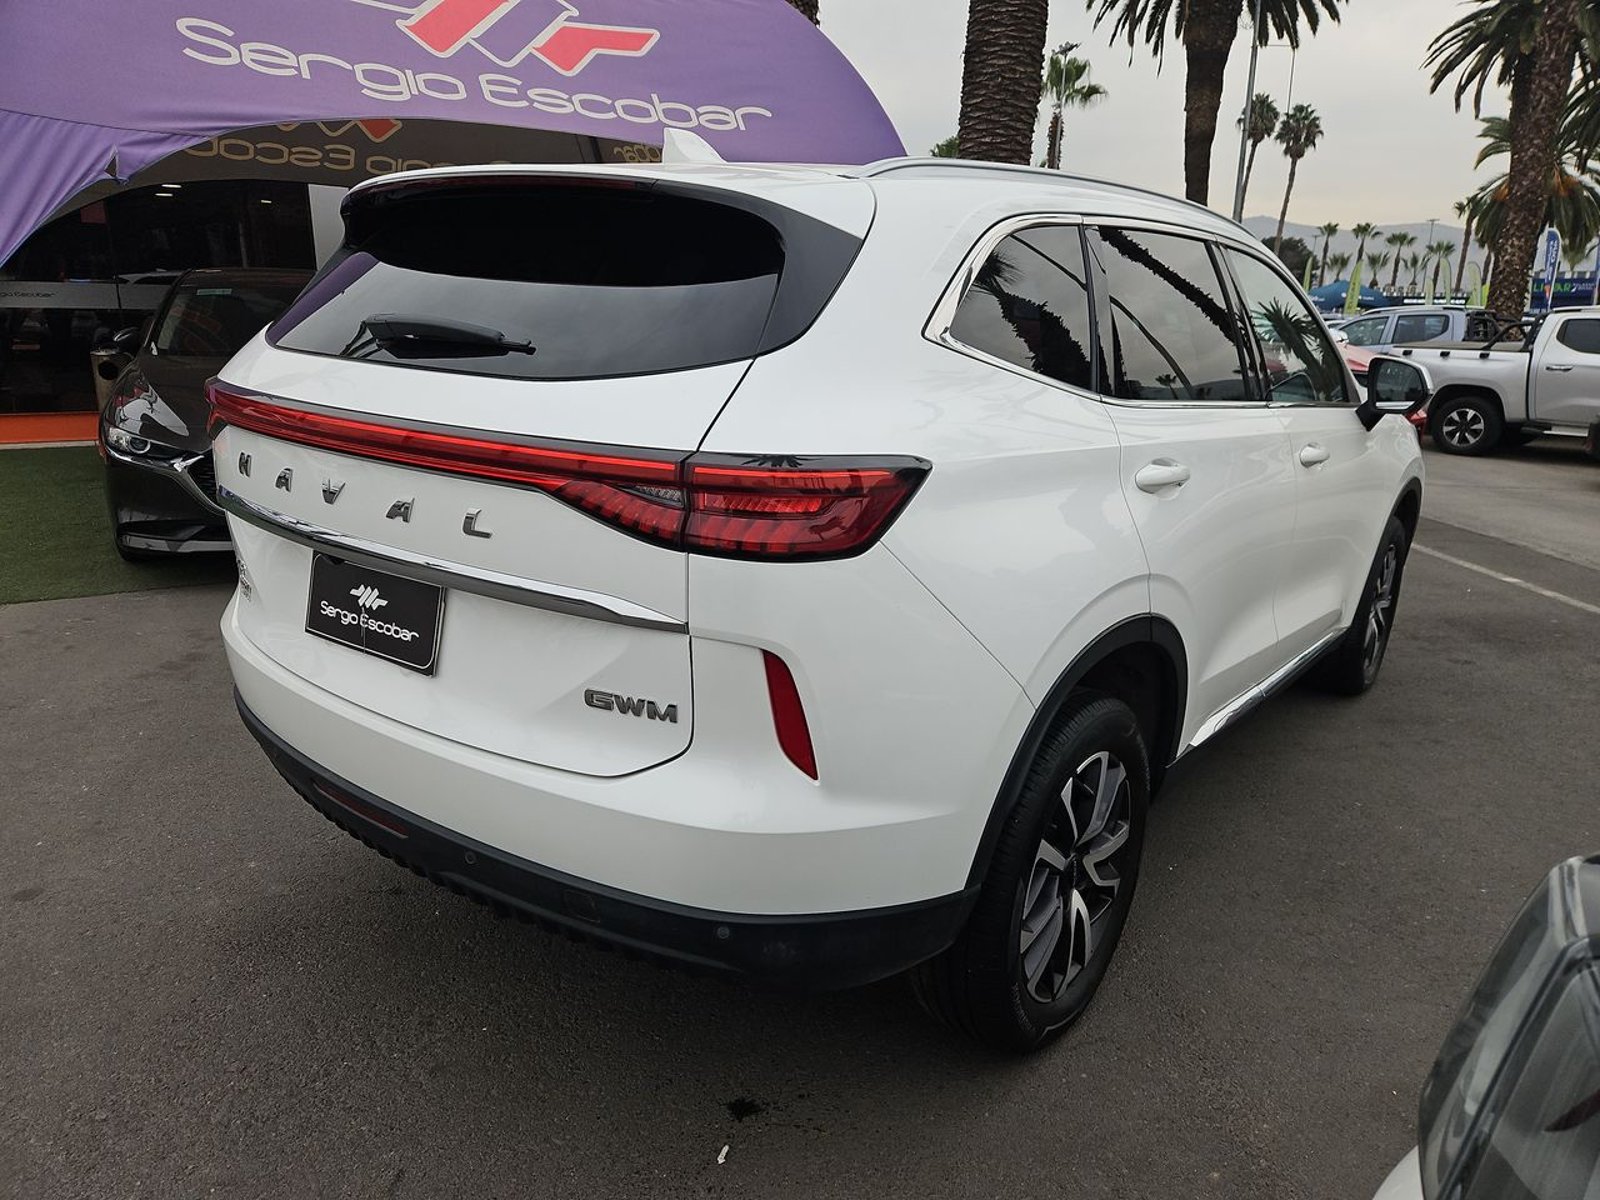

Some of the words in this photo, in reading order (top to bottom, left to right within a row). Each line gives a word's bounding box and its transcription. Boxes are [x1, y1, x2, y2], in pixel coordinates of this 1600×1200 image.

[175, 17, 467, 102] Sergio
[478, 73, 773, 131] Escobar
[238, 451, 493, 539] HAVAL
[360, 612, 420, 642] Escobar
[583, 688, 678, 724] GWM
